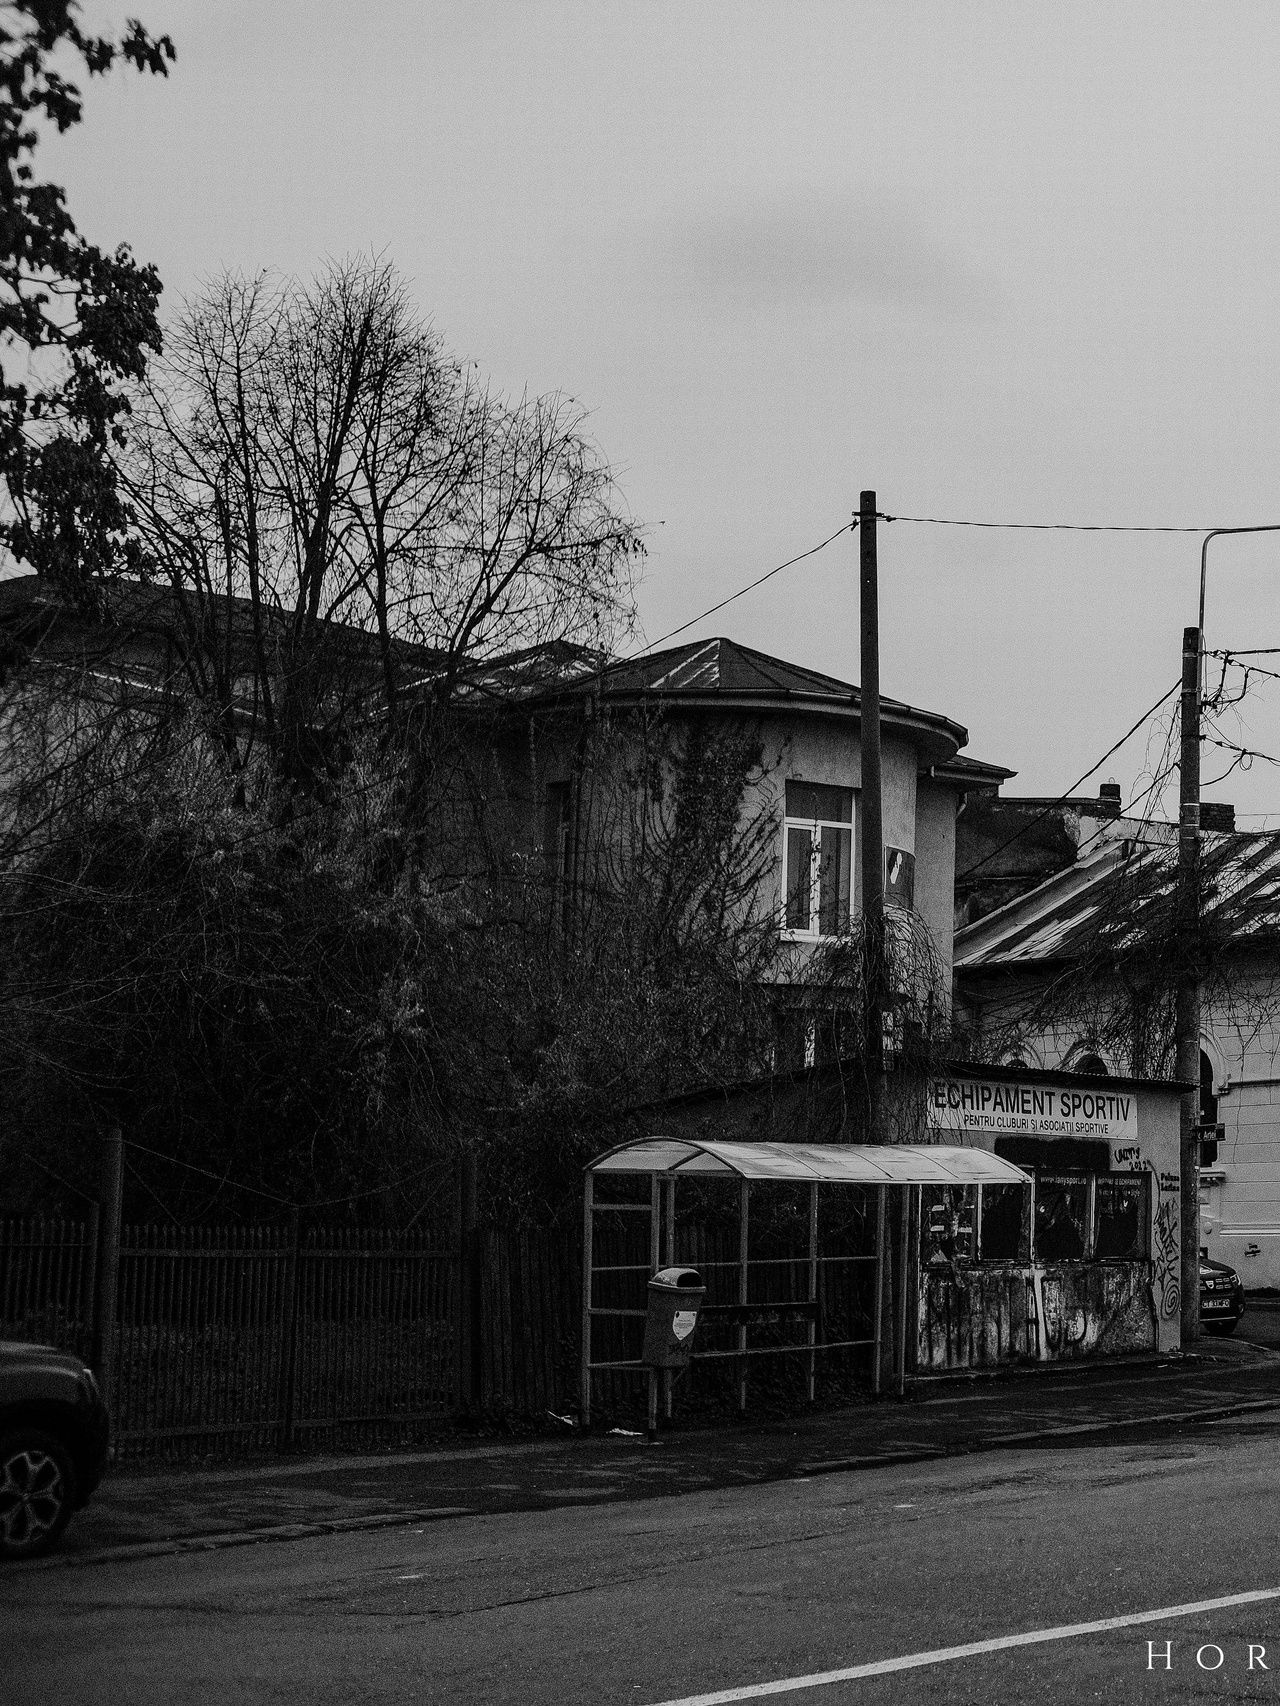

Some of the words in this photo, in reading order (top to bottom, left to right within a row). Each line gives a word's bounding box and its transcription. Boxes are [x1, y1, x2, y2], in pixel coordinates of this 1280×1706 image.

[934, 1081, 1055, 1116] ECHIPAMENT
[1060, 1092, 1130, 1122] SPORTIV
[964, 1114, 995, 1127] PENTRU
[996, 1117, 1029, 1129] CLUBURI
[1075, 1121, 1109, 1134] SPORTIVE
[1129, 1160, 1148, 1171] 2022
